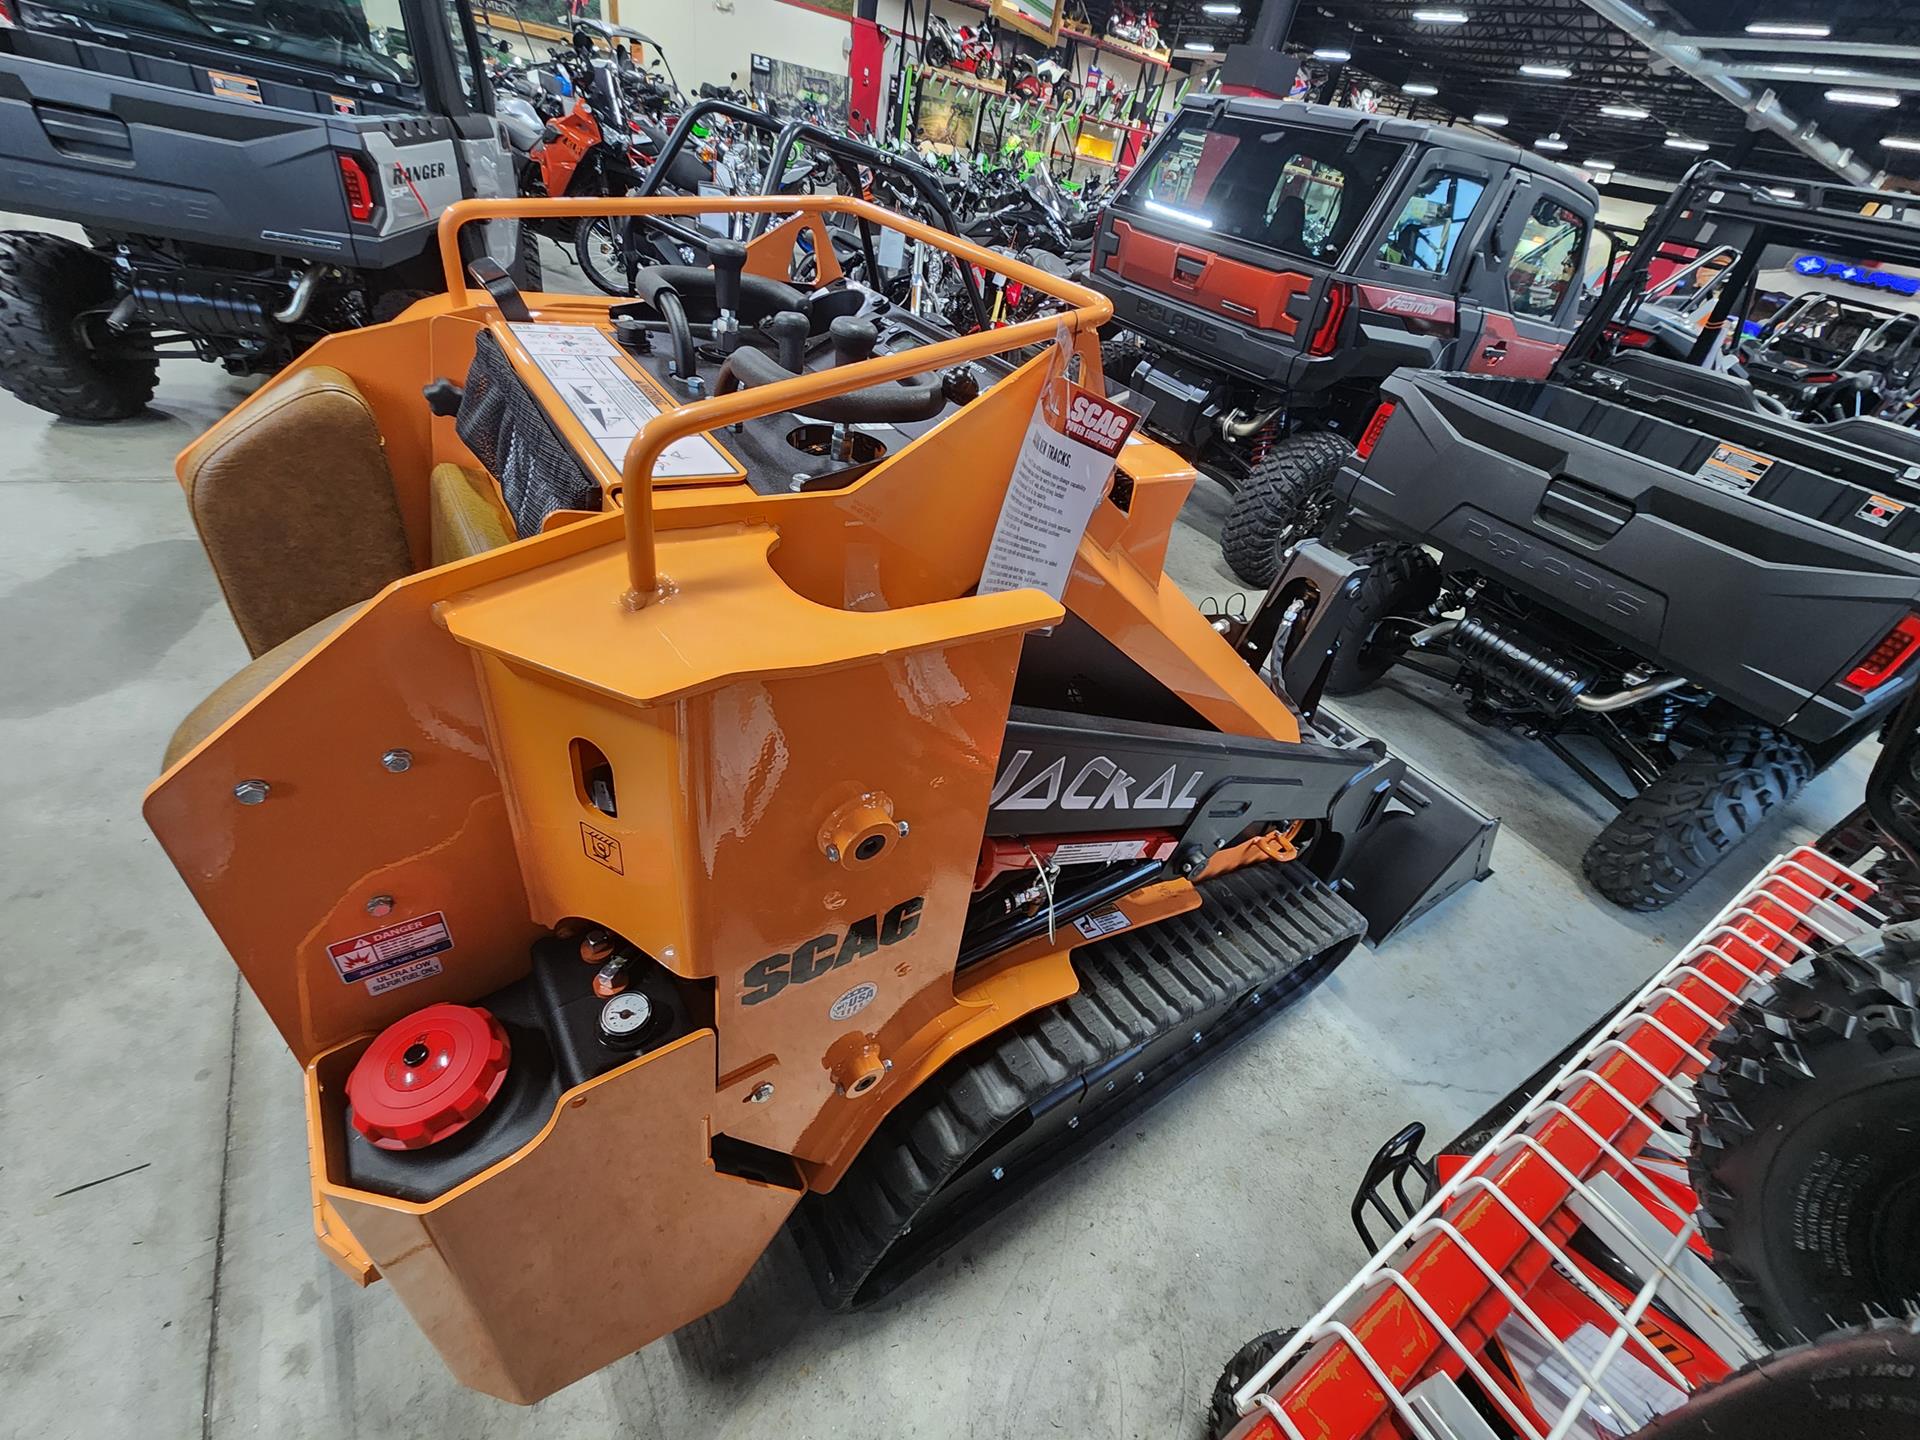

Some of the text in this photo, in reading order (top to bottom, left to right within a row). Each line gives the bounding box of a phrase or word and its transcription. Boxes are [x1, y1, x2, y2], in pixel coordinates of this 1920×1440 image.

[393, 162, 445, 186] RANGER
[1136, 299, 1217, 344] POLARIS
[1070, 396, 1128, 439] SCAG
[1065, 420, 1118, 450] POWER EQUIPMENT
[1047, 444, 1072, 468] TRACKS.
[1467, 517, 1648, 618] POLARIS
[989, 749, 1204, 810] JACKAL
[372, 921, 425, 942] DANGER
[359, 946, 440, 976] DIESEL FUEL ONLY
[740, 896, 925, 1006] SCAG
[372, 964, 440, 992] SULFUR FUEL ONLY
[376, 960, 432, 984] ULTRA LOW
[848, 988, 875, 1007] USA
